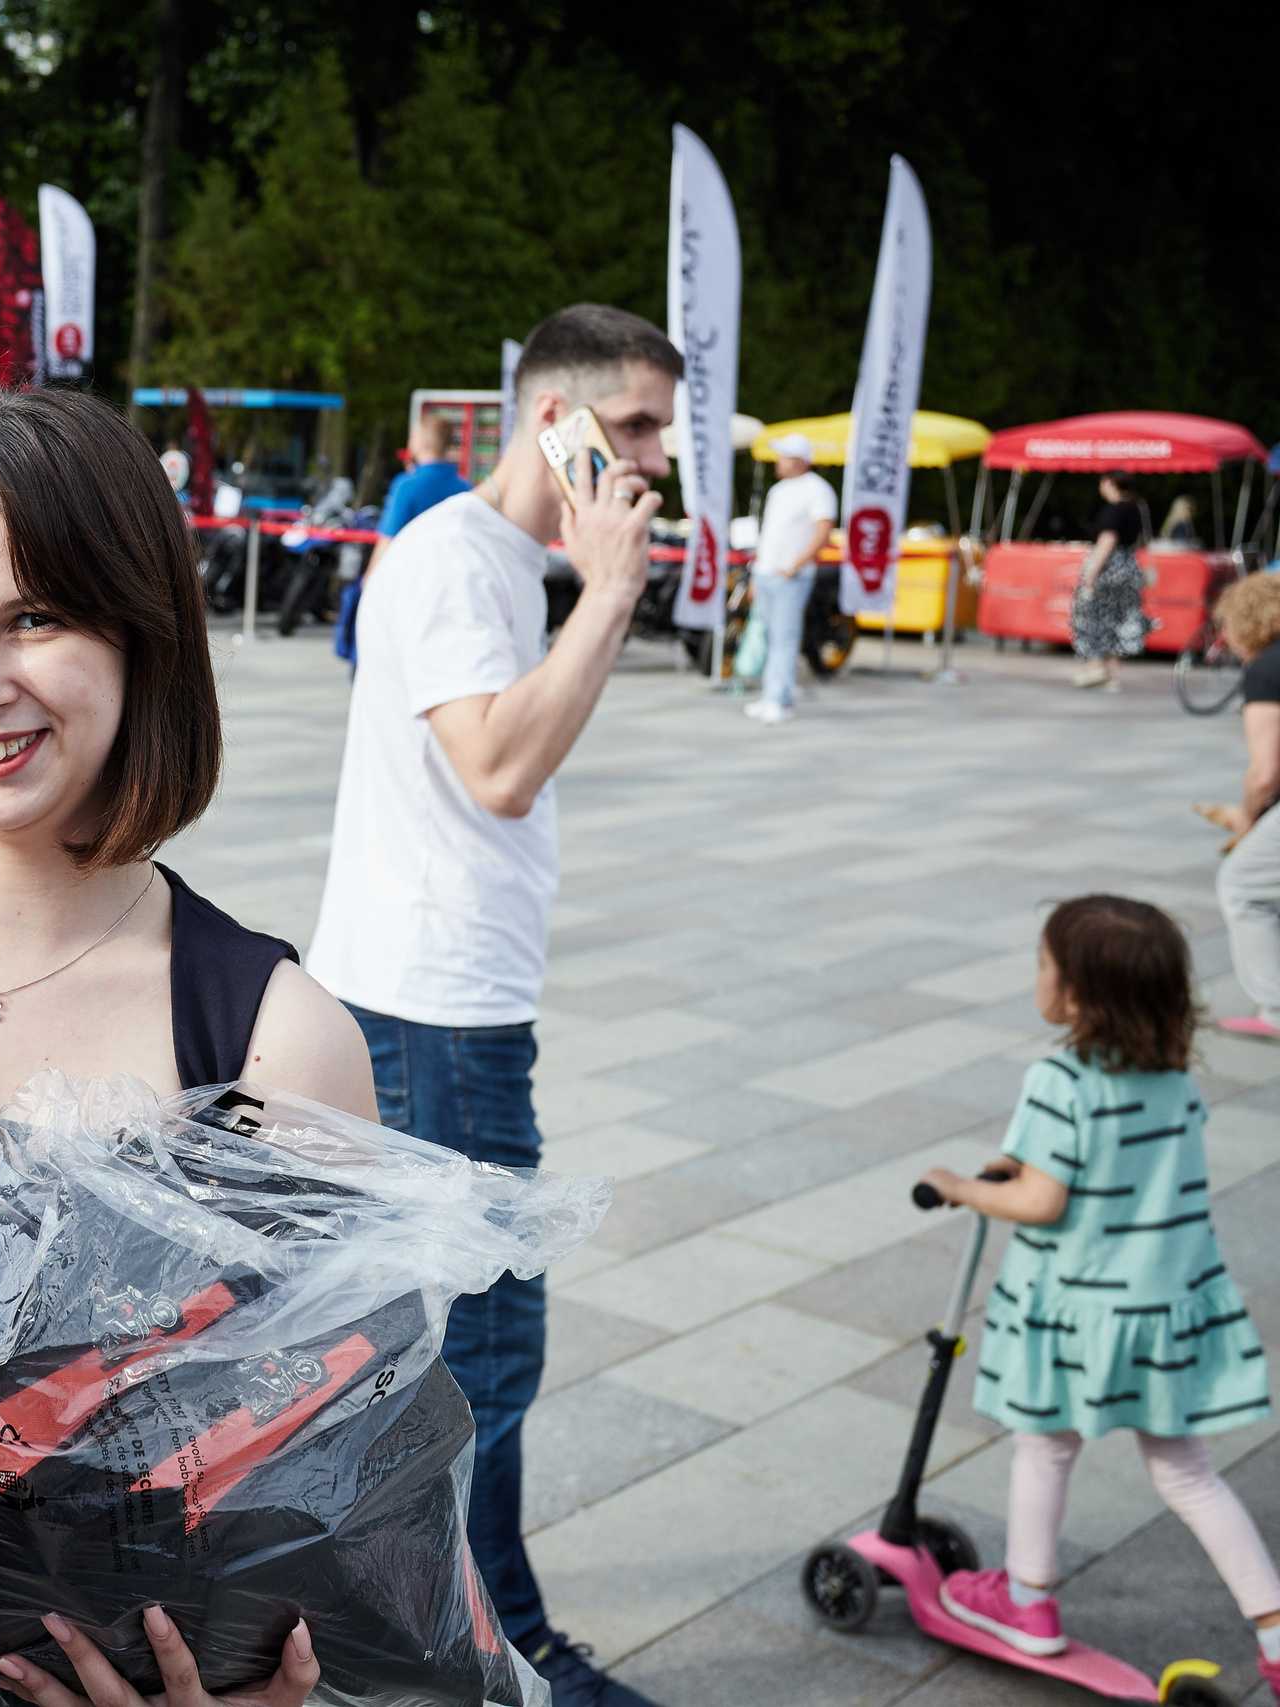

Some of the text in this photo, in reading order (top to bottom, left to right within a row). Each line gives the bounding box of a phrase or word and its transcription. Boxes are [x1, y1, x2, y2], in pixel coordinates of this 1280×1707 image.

[117, 1446, 130, 1461] de
[131, 1439, 145, 1458] DE
[104, 1465, 114, 1475] et
[156, 1371, 172, 1394] ETY
[188, 1435, 208, 1467] avoid
[200, 1523, 211, 1553] keep
[106, 1478, 119, 1498] des
[121, 1464, 136, 1530] suffocation,
[169, 1428, 183, 1453] from
[184, 1518, 198, 1558] hildren
